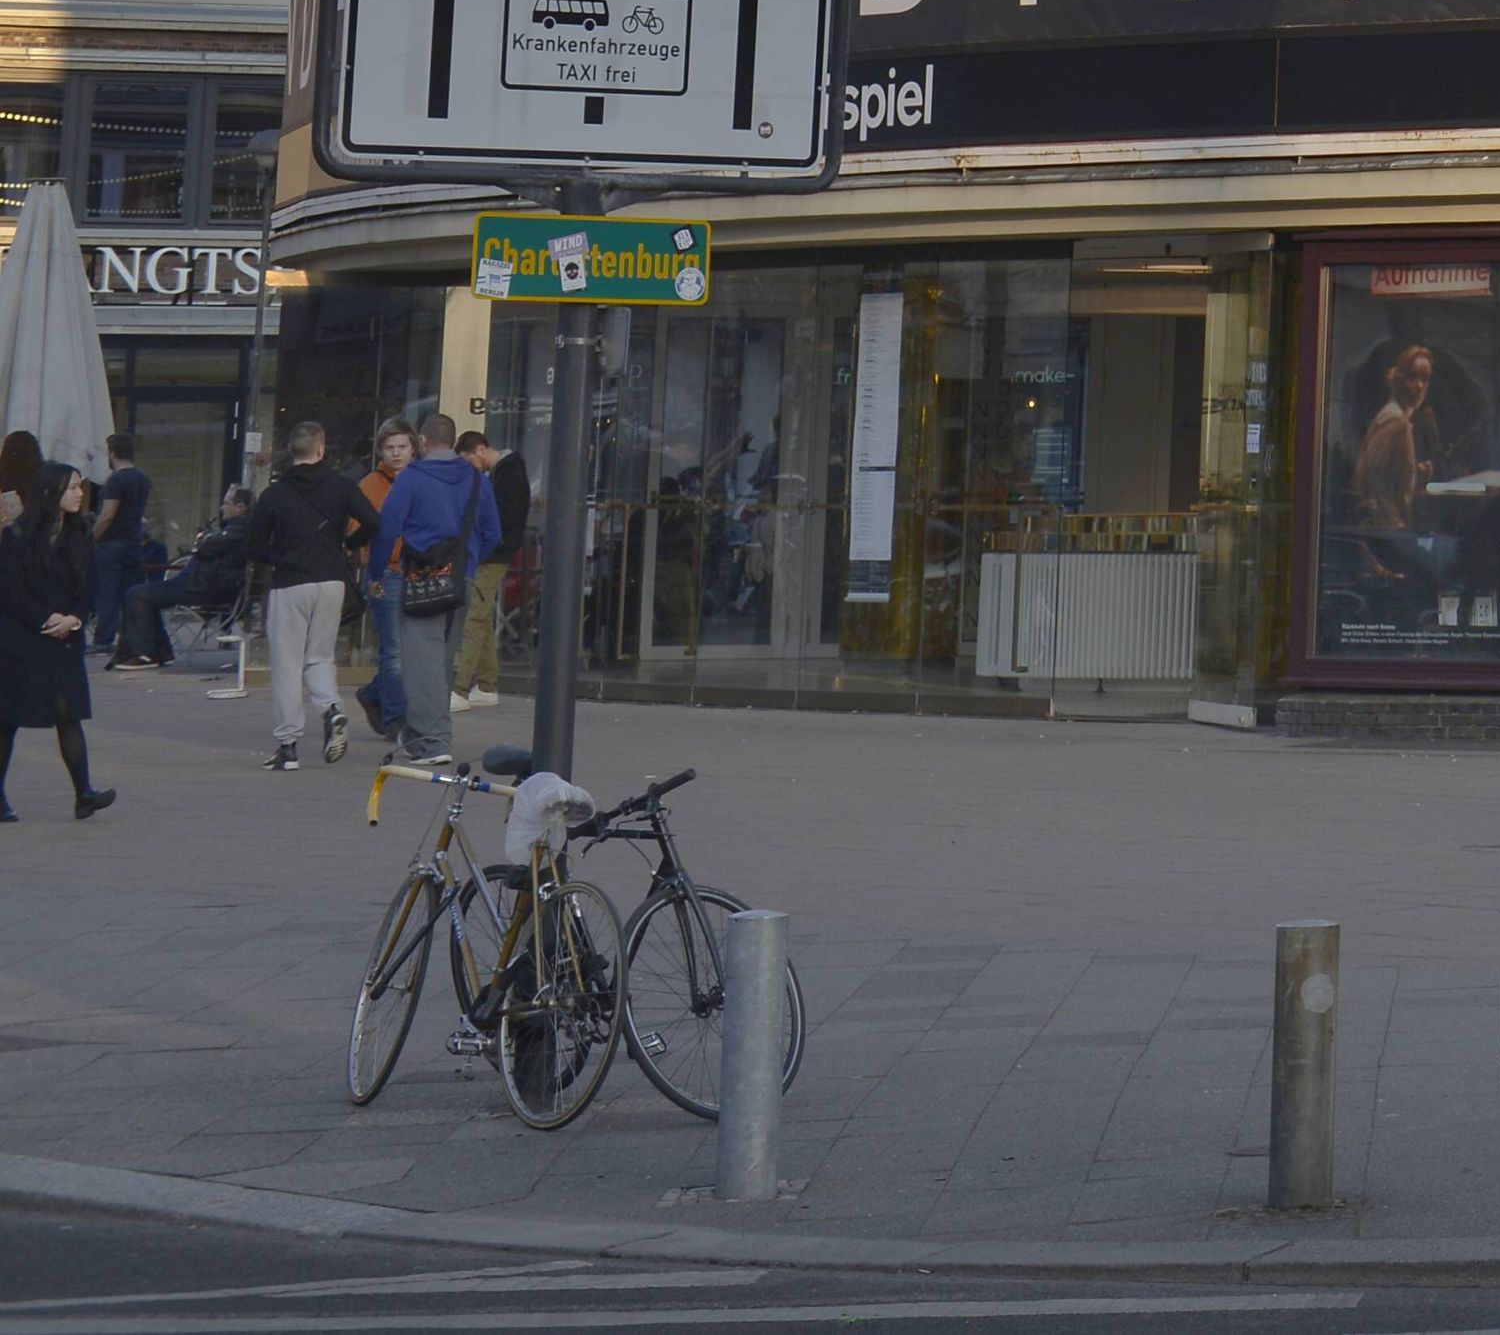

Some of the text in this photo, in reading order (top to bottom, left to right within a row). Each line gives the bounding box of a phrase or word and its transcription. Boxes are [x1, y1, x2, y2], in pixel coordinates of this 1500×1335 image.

[512, 33, 681, 61] Krankenfahrzeuge
[557, 63, 636, 83] TAXI frei
[553, 233, 583, 253] WIND
[88, 246, 270, 295] NGTS
[484, 235, 702, 280] Chartenbur
